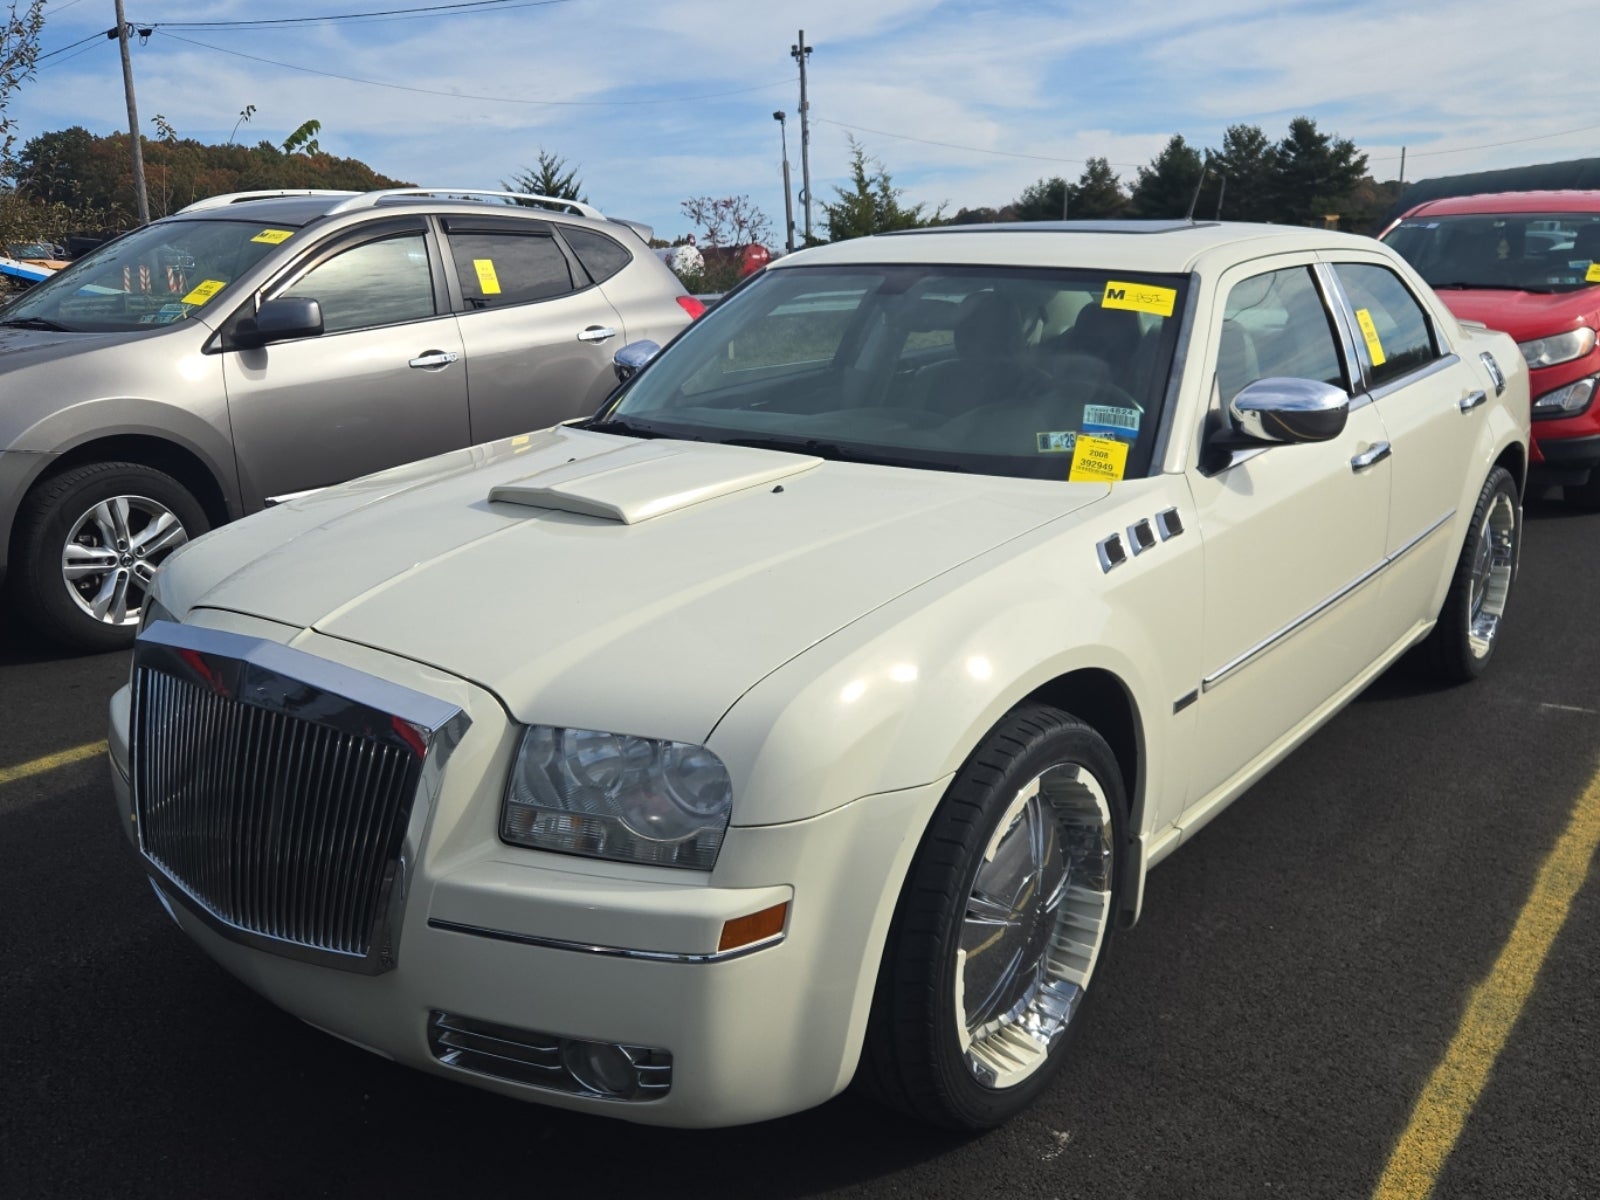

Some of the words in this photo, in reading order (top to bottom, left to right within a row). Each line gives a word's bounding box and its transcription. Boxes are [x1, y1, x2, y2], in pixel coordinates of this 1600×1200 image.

[1107, 288, 1126, 301] M
[1089, 449, 1109, 459] 2008
[1080, 458, 1113, 472] 392949
